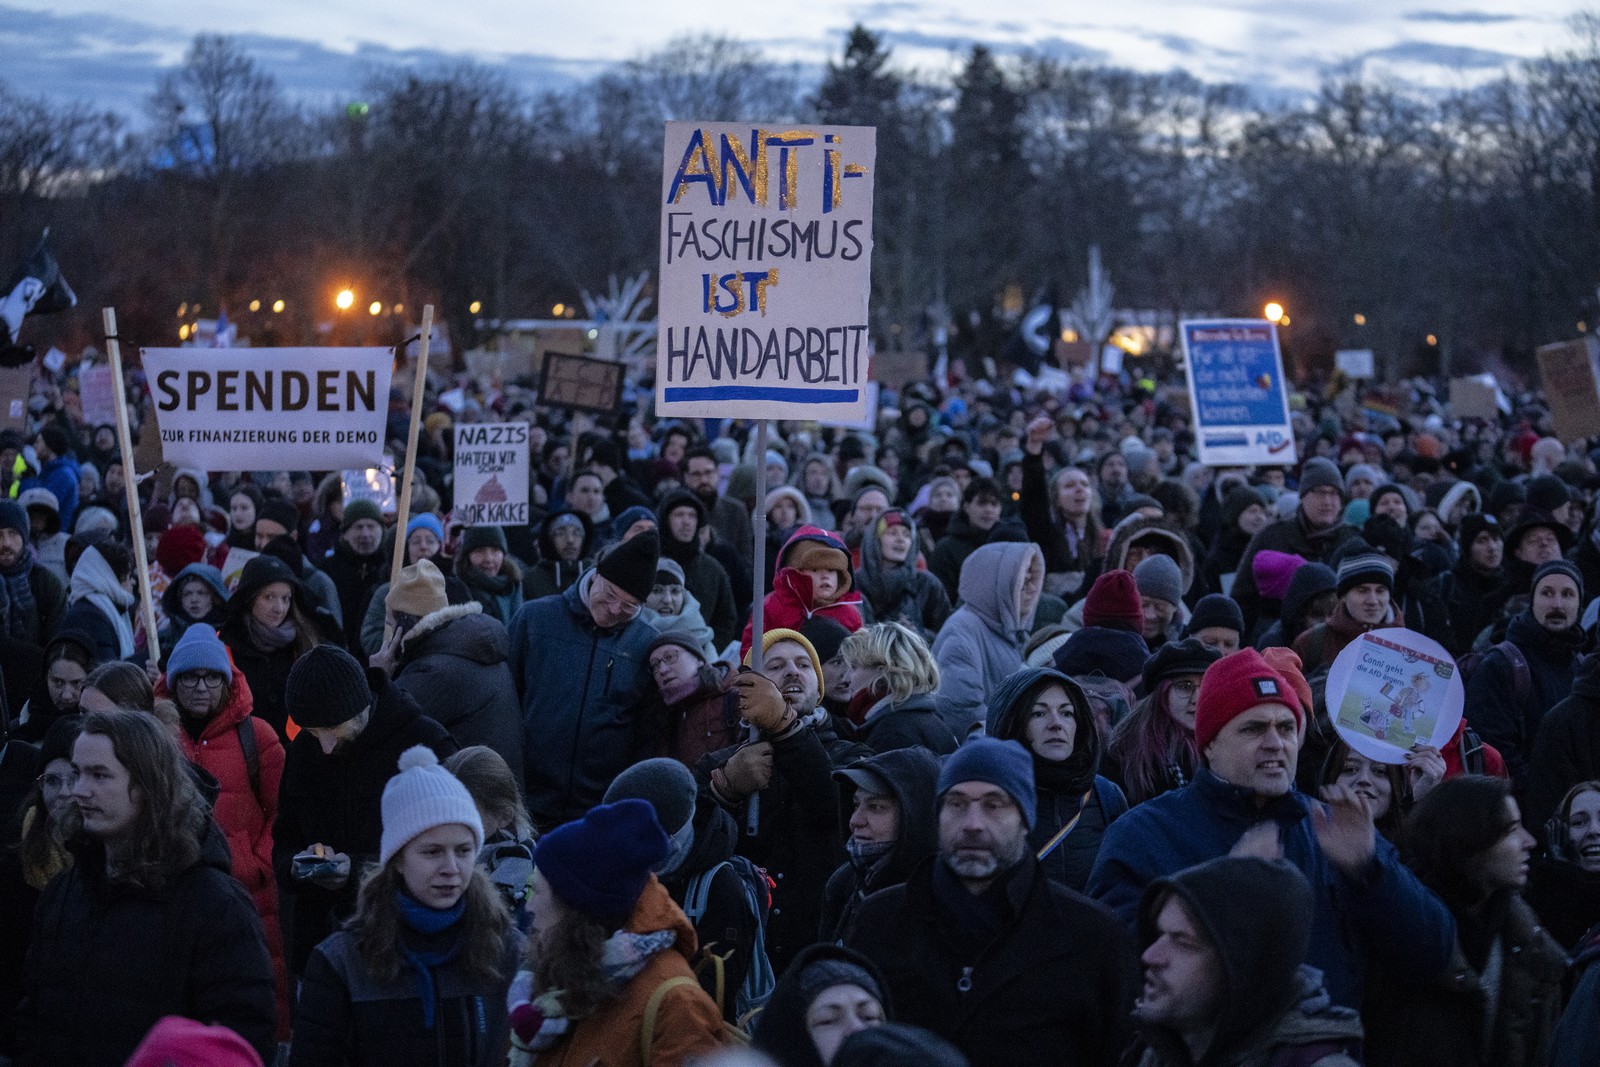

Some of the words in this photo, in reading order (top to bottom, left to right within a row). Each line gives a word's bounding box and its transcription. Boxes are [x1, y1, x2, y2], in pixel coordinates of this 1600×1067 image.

[667, 212, 863, 264] FASCHISMUS
[702, 267, 779, 318] IST
[667, 325, 868, 385] HANDARBEIT
[157, 370, 376, 411] SPENDEN
[162, 429, 184, 442] ZUR
[189, 430, 297, 443] FINANZIERUNG
[303, 431, 330, 443] DER
[336, 431, 378, 443] DEMO
[459, 426, 526, 445] NAZIS
[488, 502, 527, 522] KACKE
[1356, 663, 1368, 673] die
[1368, 669, 1382, 678] AfD
[1362, 652, 1385, 668] Conni
[1385, 663, 1403, 676] geht
